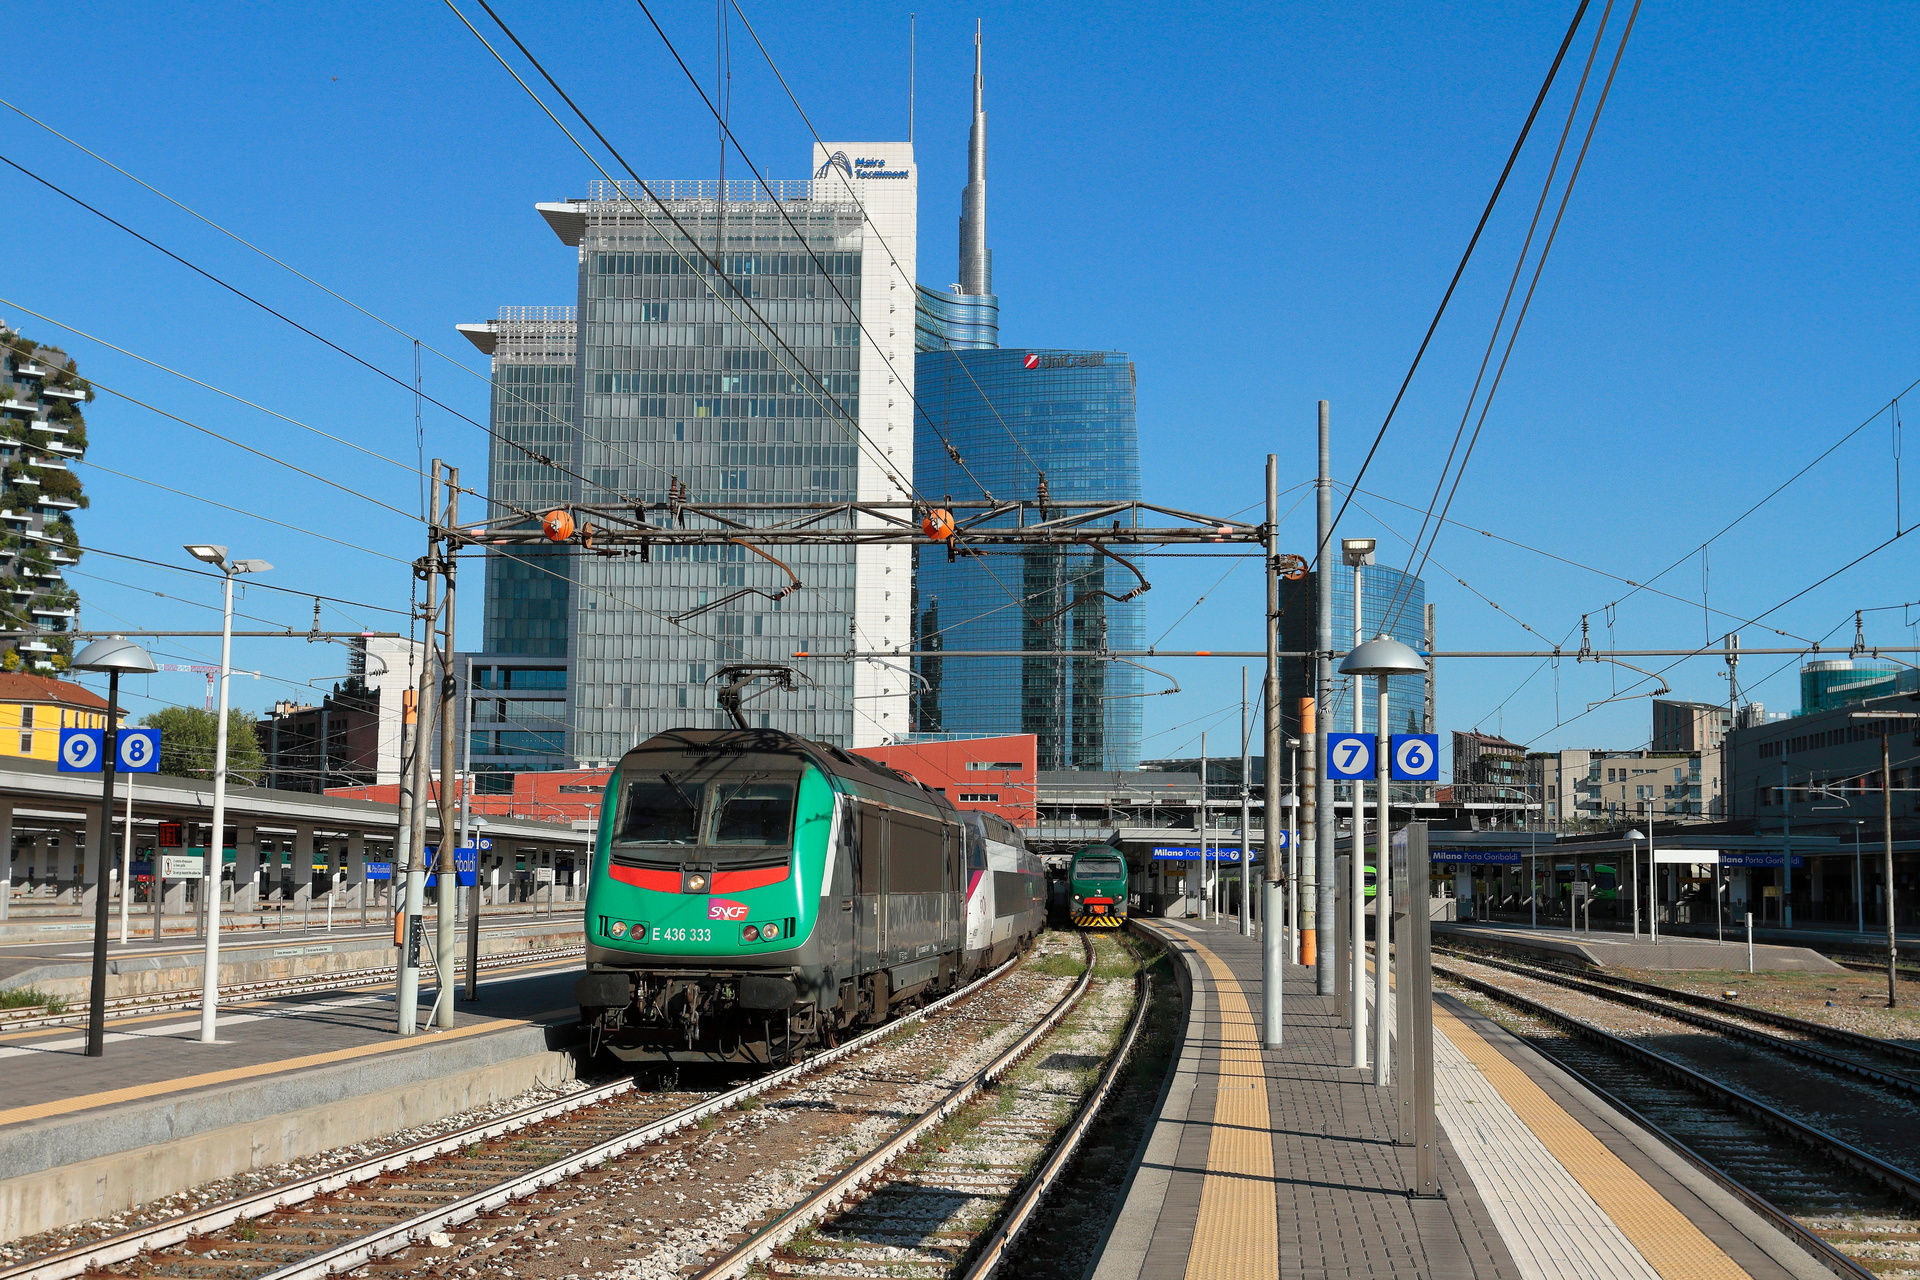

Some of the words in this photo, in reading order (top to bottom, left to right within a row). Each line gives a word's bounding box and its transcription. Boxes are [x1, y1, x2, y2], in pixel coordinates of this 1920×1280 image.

[855, 158, 885, 168] Maire
[855, 169, 909, 179] Tecnimont
[1041, 353, 1106, 368] UniCredit
[71, 740, 89, 762] 9
[129, 739, 145, 762] 8
[1342, 745, 1362, 768] 7
[1405, 745, 1425, 769] 6
[1154, 849, 1183, 857] Milano
[1432, 852, 1462, 860] Milano
[1464, 852, 1482, 860] Porta
[1484, 852, 1518, 860] Garibaldi
[1719, 855, 1743, 863] ilano
[1745, 856, 1764, 864] Porta
[709, 906, 748, 918] SNCF
[652, 927, 661, 941] E
[664, 927, 686, 941] 436
[690, 928, 711, 942] 333
